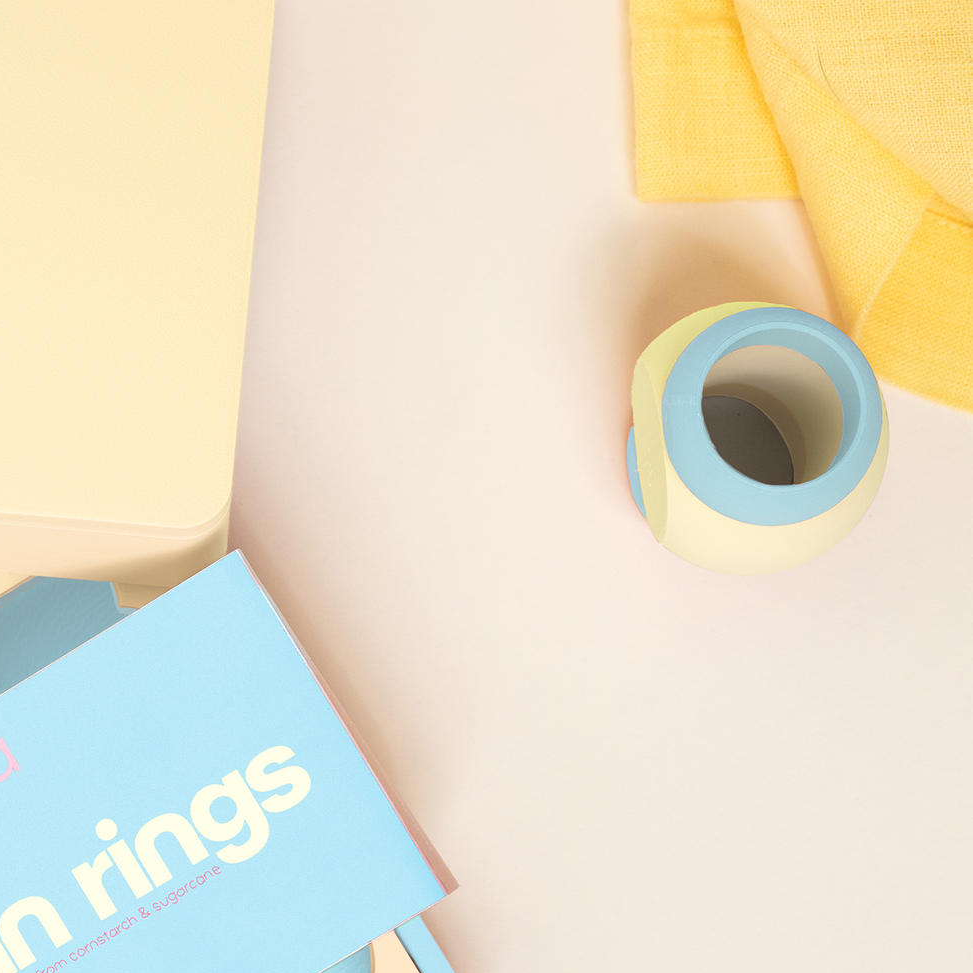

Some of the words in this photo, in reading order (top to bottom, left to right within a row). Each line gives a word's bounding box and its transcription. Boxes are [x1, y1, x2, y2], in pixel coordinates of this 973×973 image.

[72, 746, 311, 920] rings
[69, 917, 138, 961] cornstarch
[138, 907, 151, 919] &
[152, 866, 221, 911] sugarcane
